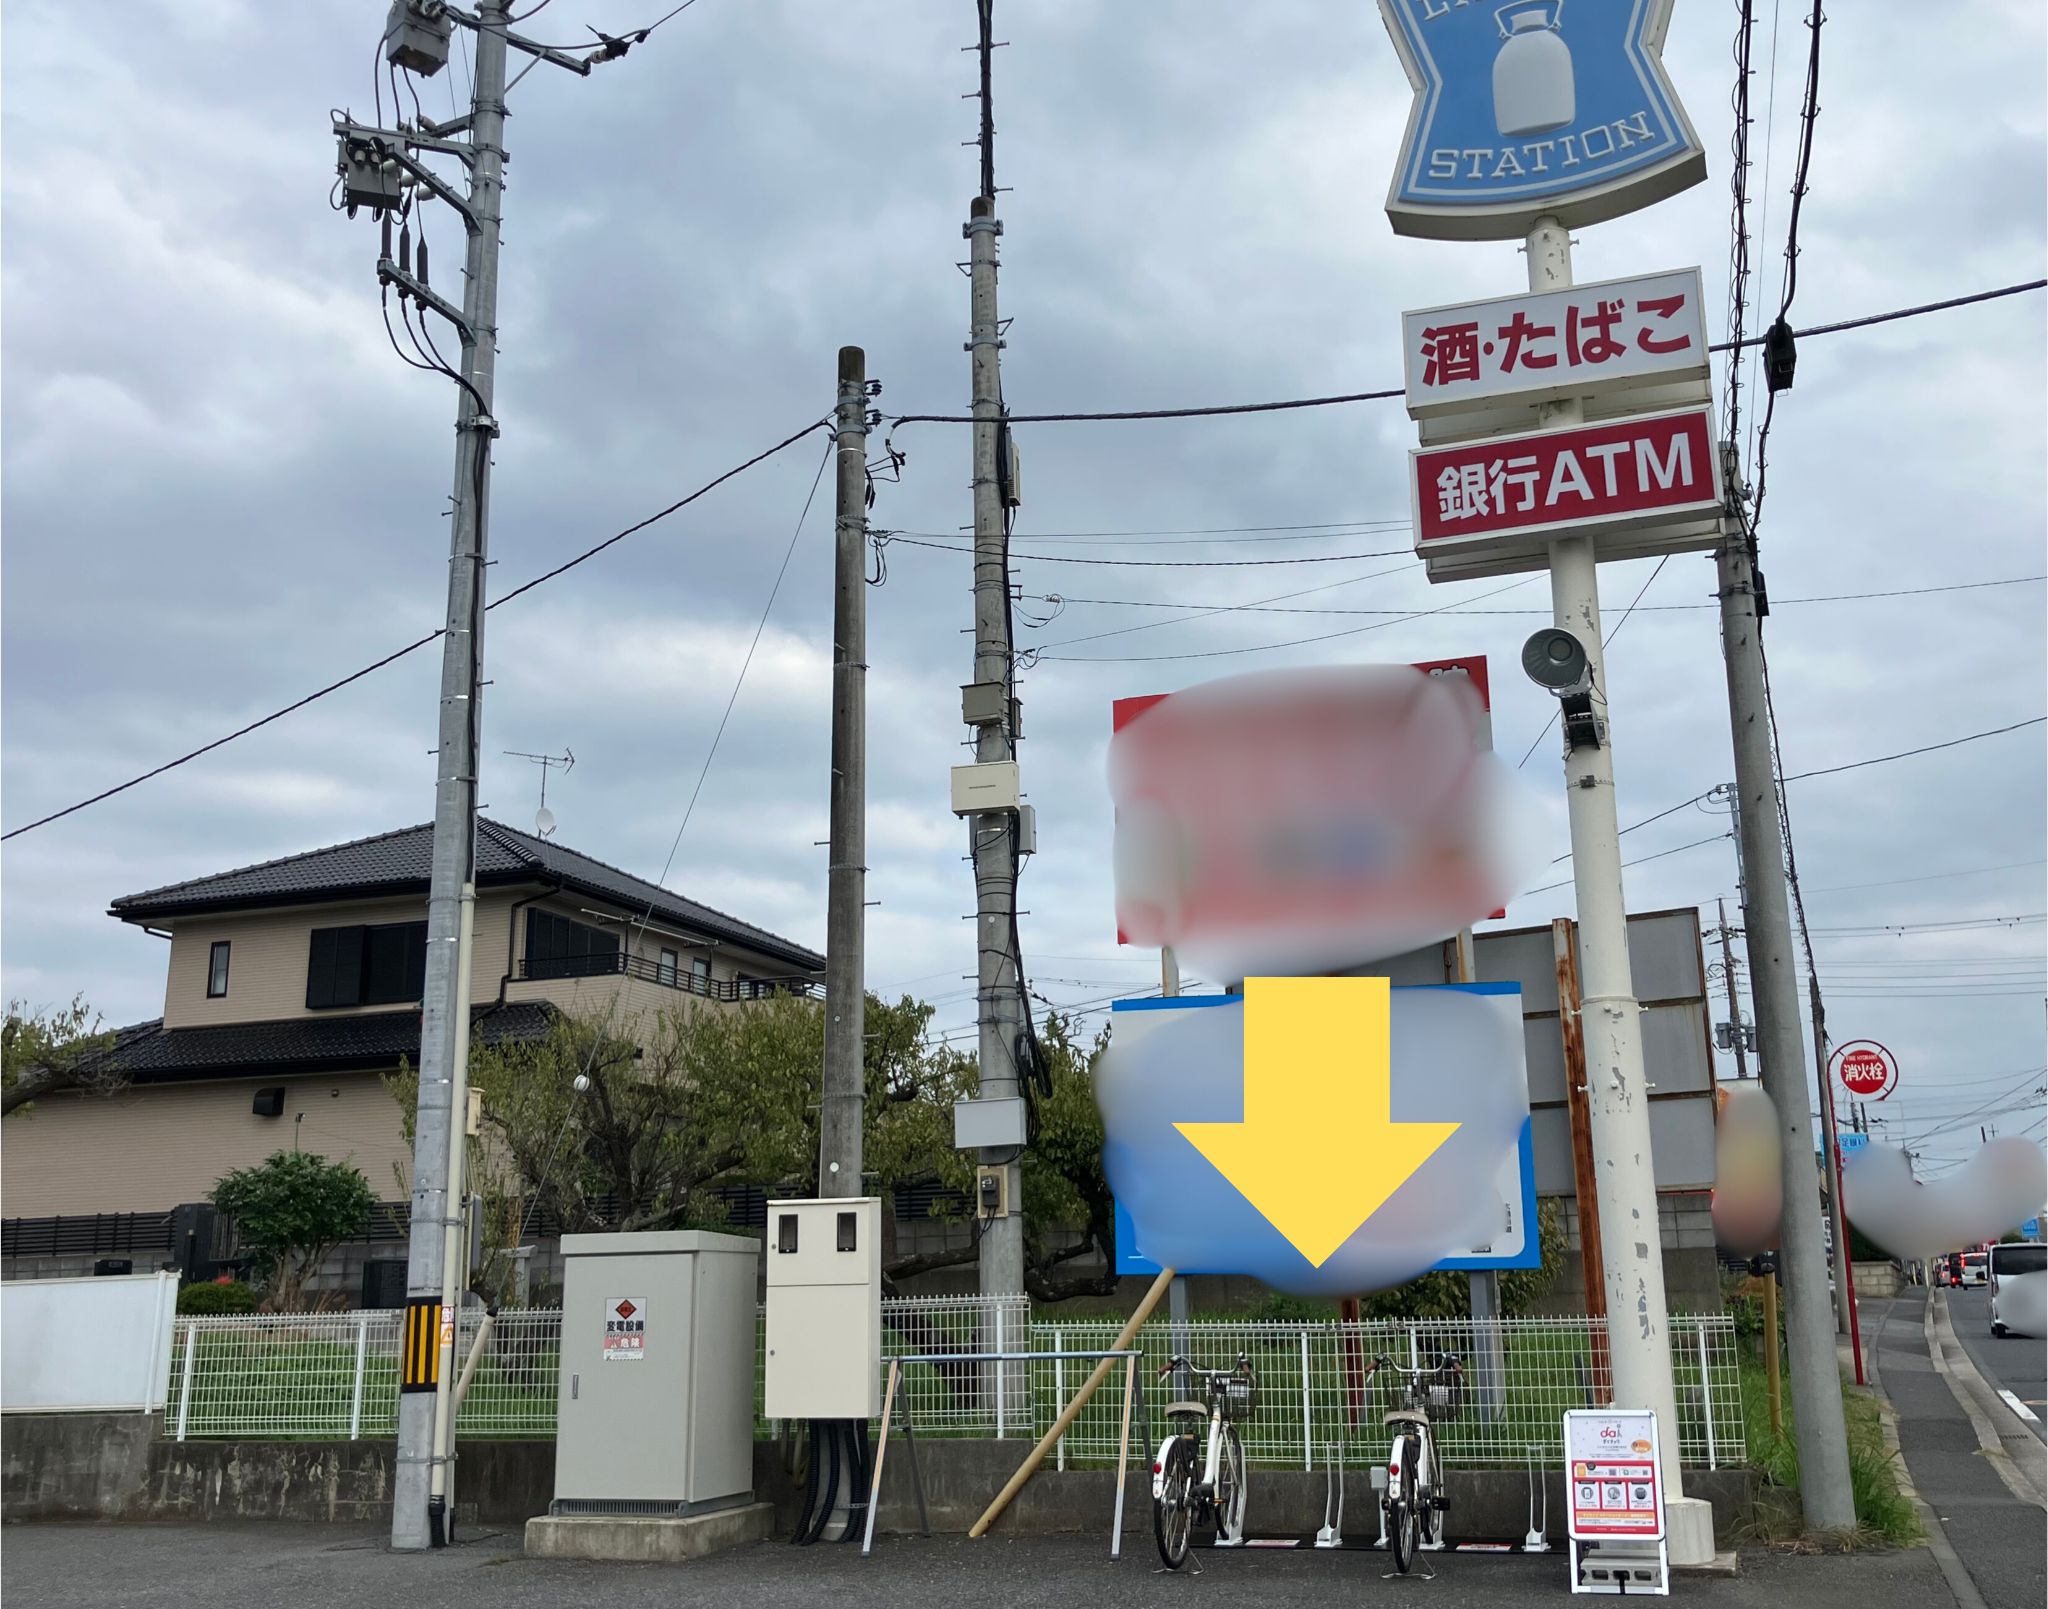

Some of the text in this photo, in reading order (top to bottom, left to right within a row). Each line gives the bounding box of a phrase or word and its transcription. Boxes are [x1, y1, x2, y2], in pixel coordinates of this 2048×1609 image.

[1428, 110, 1655, 181] STATION
[1436, 431, 1695, 522] 銀行ATM
[1843, 1062, 1885, 1082] 消火栓
[607, 1320, 644, 1332] 変電設備
